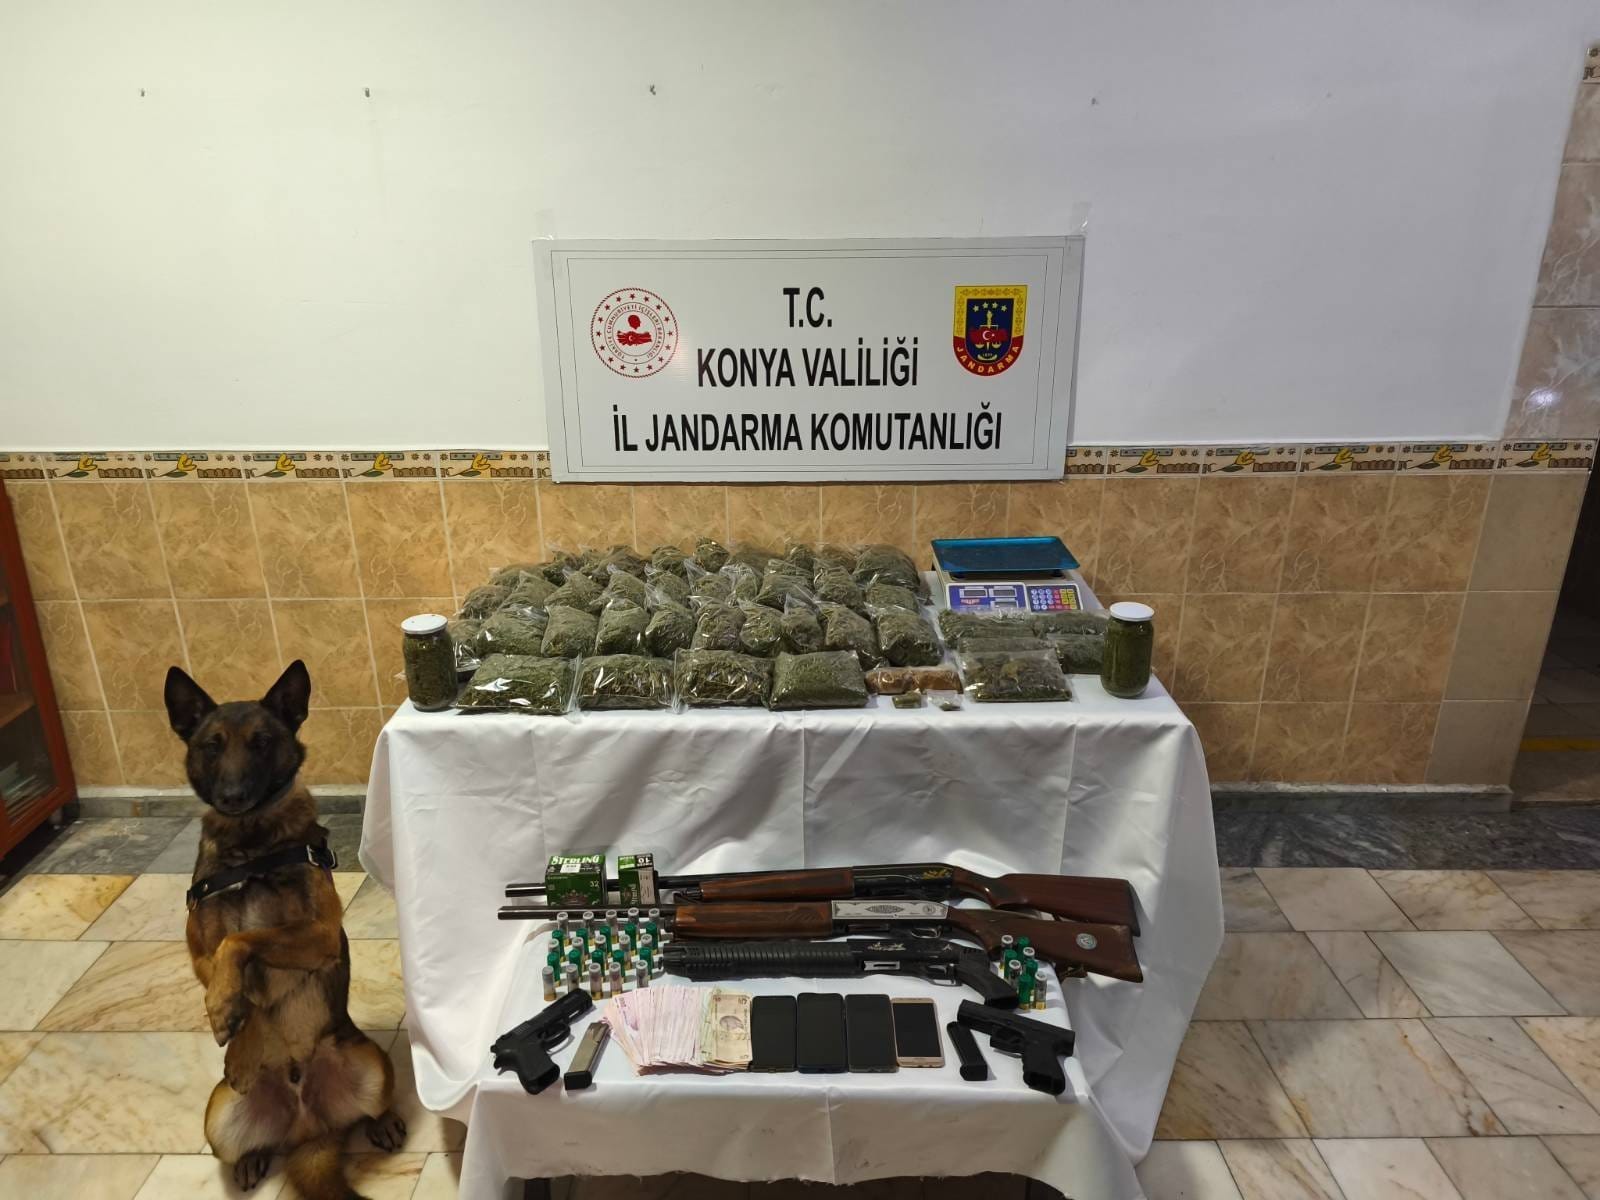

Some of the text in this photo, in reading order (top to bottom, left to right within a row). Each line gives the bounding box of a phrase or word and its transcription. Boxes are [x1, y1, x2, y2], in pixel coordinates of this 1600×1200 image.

[782, 286, 833, 328] T.C.
[697, 336, 919, 388] KONYA VALİLİĞİ
[956, 345, 1020, 373] JANDARMA
[612, 401, 1002, 452] İL JANDARMA KOMUTANLIĞI
[551, 855, 599, 865] STERLING
